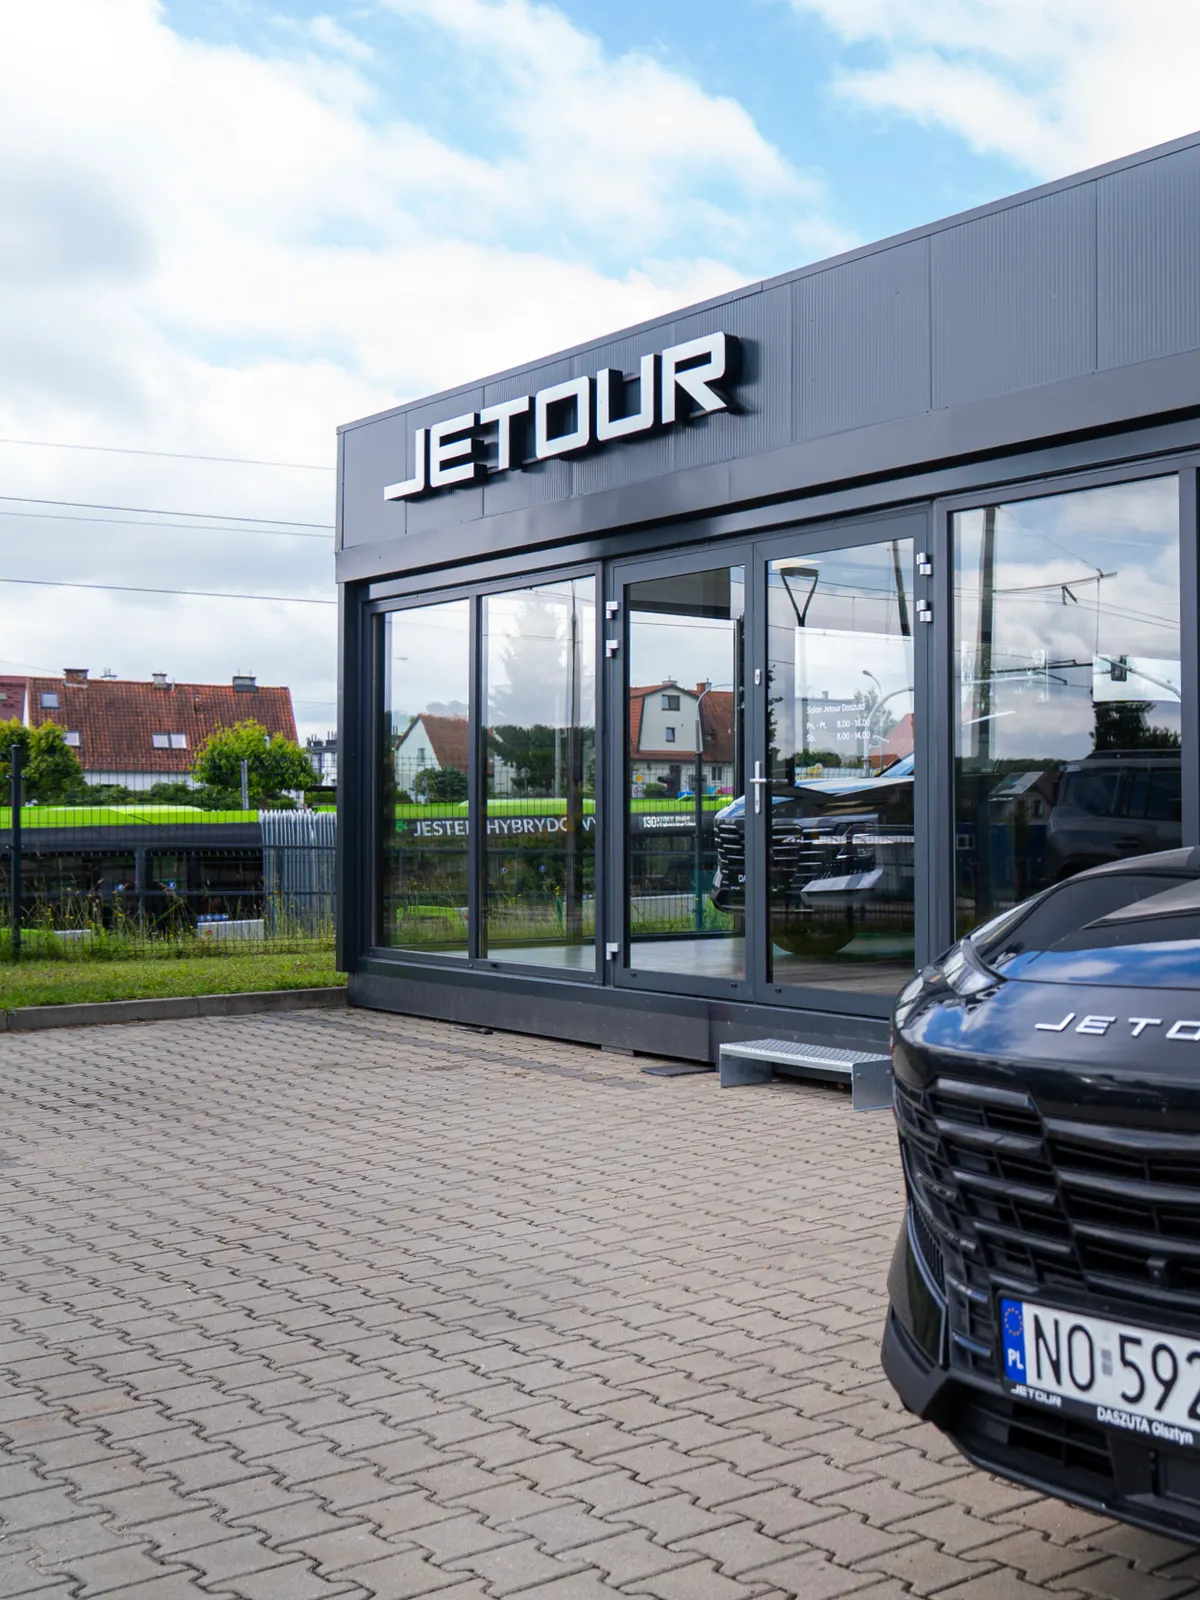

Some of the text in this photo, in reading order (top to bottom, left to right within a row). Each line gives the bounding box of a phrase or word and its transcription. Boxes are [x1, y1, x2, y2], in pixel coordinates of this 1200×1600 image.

[384, 331, 729, 501] JETOUR
[823, 704, 841, 713] Jetour
[413, 820, 469, 837] JESTE
[1007, 1348, 1024, 1371] PL
[1033, 1312, 1095, 1392] NO
[1010, 1384, 1063, 1408] JETOUR
[1097, 1406, 1194, 1447] DASZUTA Olsztyn
